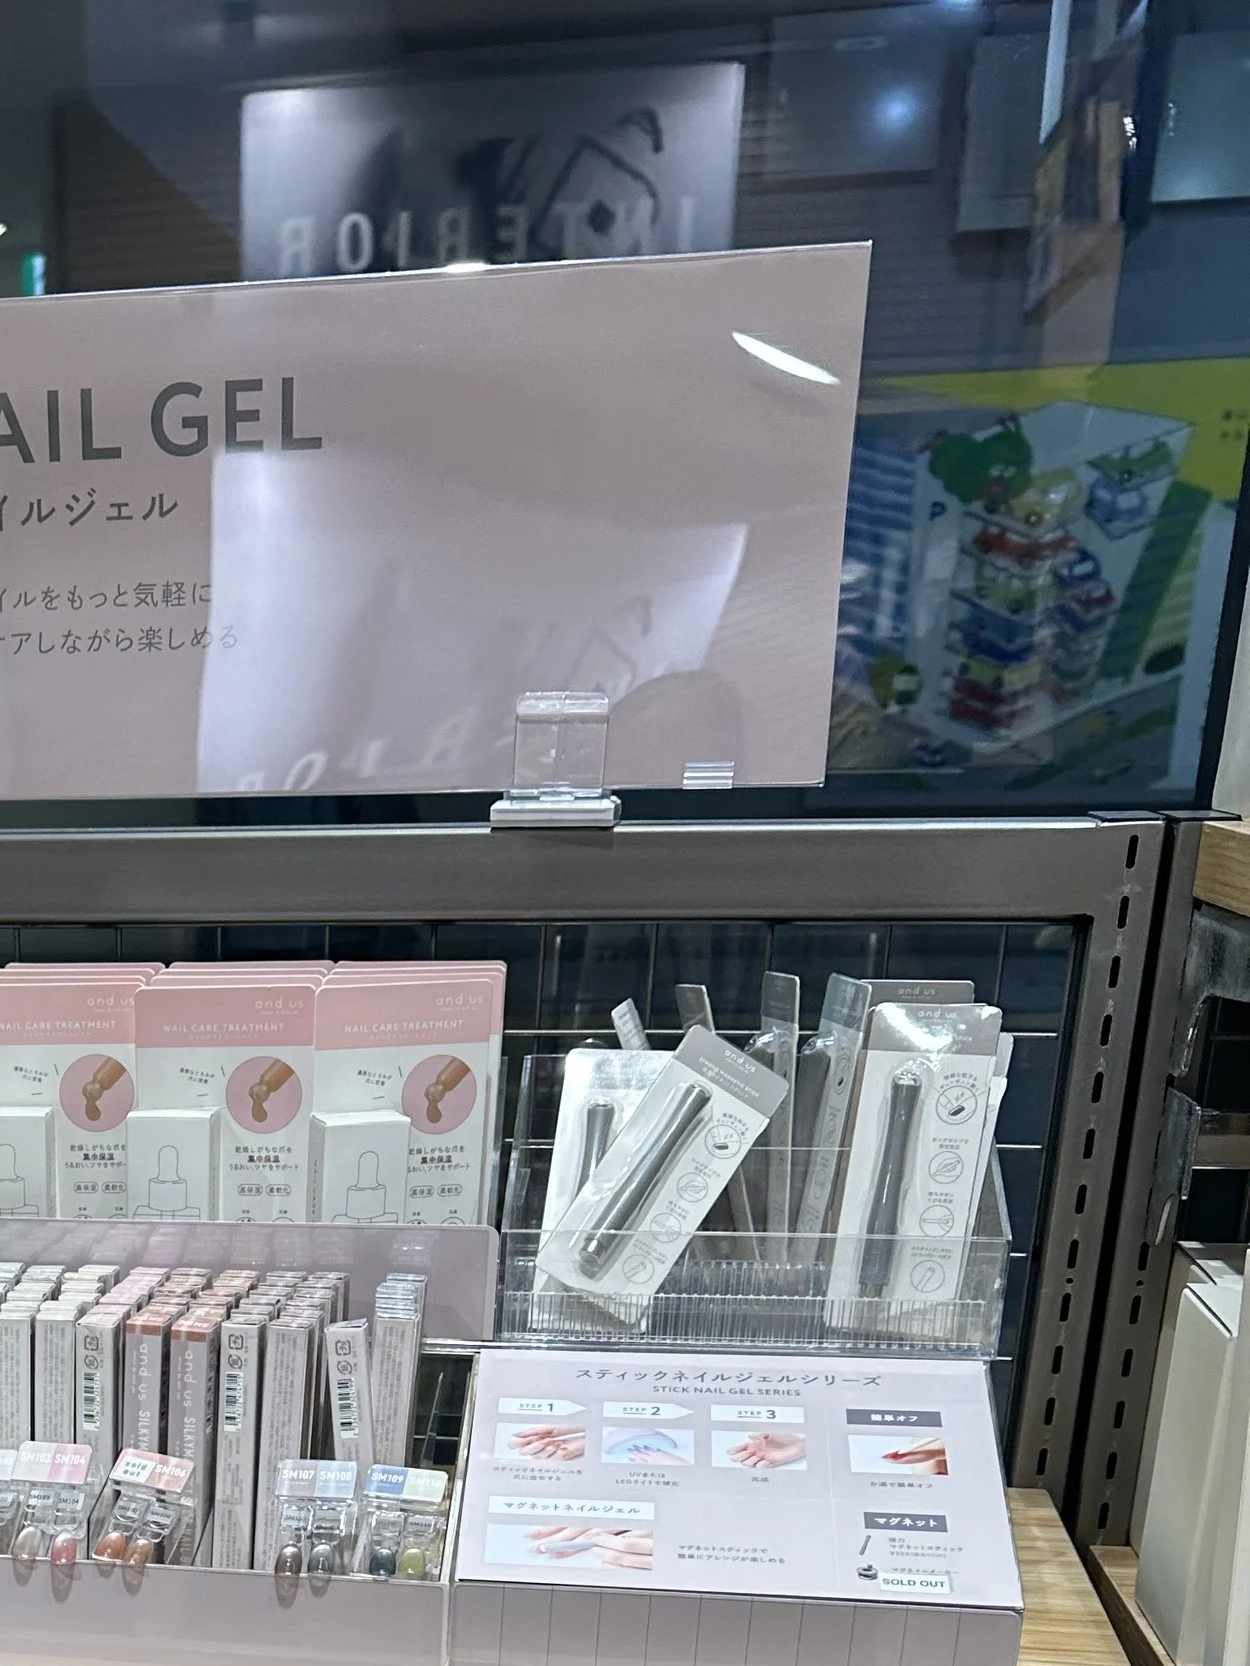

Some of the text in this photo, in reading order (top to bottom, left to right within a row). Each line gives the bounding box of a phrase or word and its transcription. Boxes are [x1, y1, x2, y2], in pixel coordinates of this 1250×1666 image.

[149, 376, 324, 457] GEL
[86, 994, 115, 1007] and
[254, 997, 305, 1010] and us
[435, 993, 485, 1006] and us
[29, 1020, 55, 1031] CARE
[58, 1019, 117, 1031] TREATMENT
[163, 1022, 285, 1033] NAIL CARE TREATMENT
[344, 1019, 464, 1034] NAIL CARE TREATMENT
[138, 1343, 152, 1402] and us
[182, 1350, 198, 1408] and us
[575, 1368, 882, 1387] スティックネイルジェルシリーズ
[652, 1384, 802, 1397] STICK NAIL GEL SERIES
[547, 1402, 555, 1413] 1
[650, 1406, 662, 1417] 2
[765, 1409, 777, 1420] 3
[870, 1413, 919, 1423] 簡単オフ
[20, 1451, 87, 1467] SM103 SM104
[124, 1460, 148, 1472] sold
[154, 1464, 187, 1479] SM106
[123, 1469, 142, 1479] out
[281, 1468, 352, 1481] SM107 SM108
[370, 1471, 404, 1484] SM109
[503, 1500, 641, 1515] マグネットネイルジェル
[873, 1515, 940, 1530] マグネット
[882, 1577, 946, 1590] SOLD OUT
